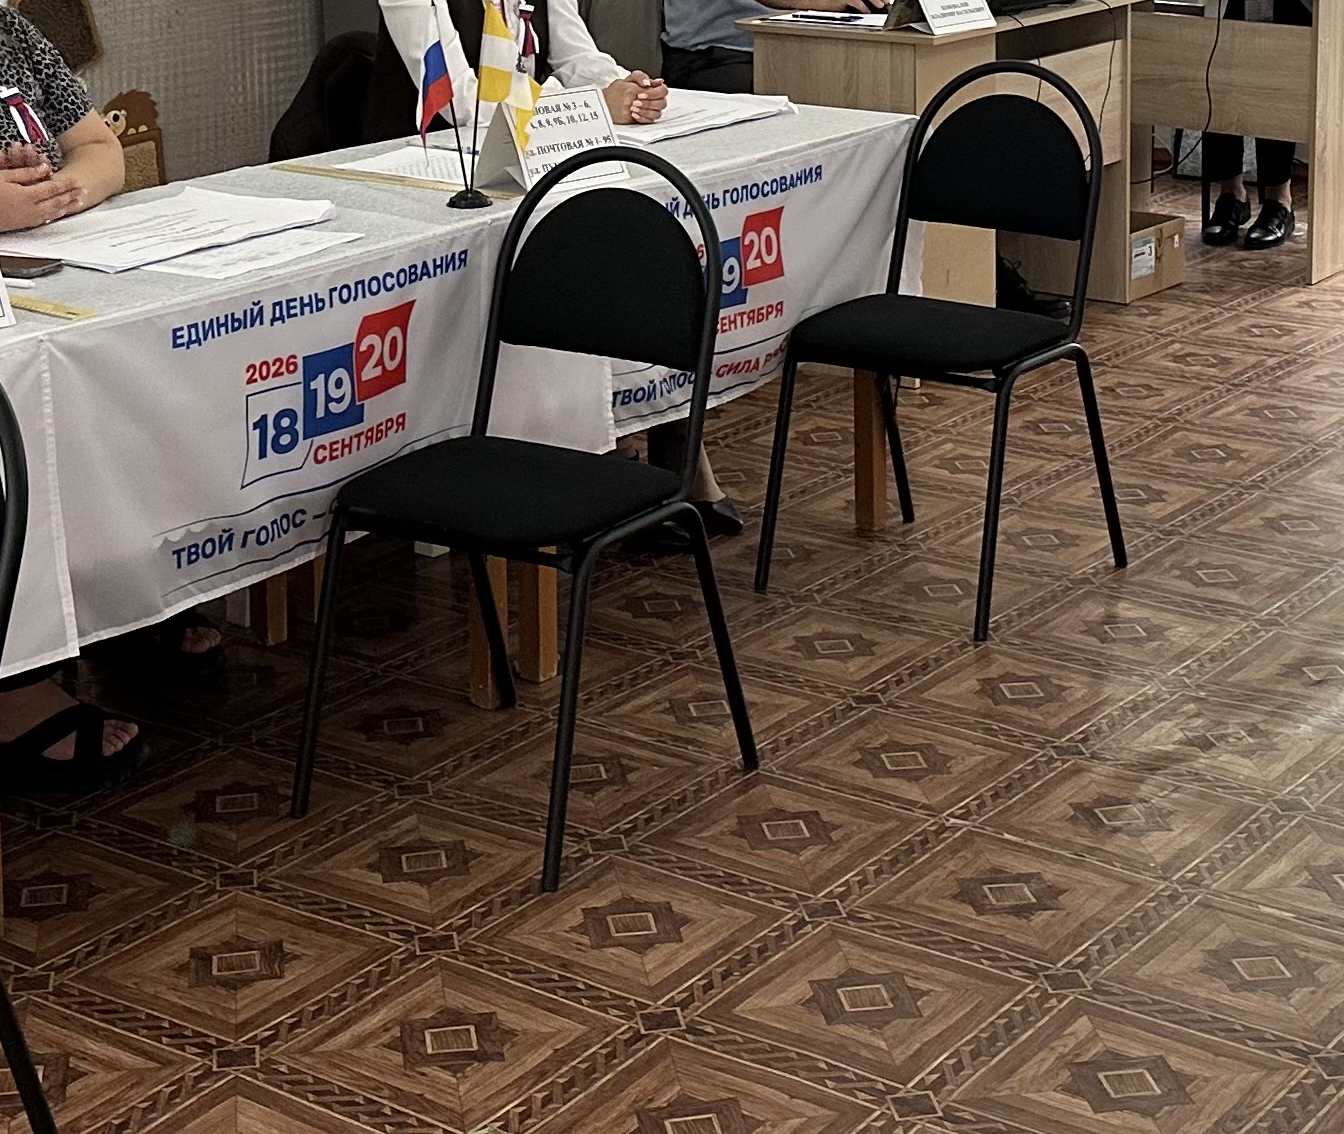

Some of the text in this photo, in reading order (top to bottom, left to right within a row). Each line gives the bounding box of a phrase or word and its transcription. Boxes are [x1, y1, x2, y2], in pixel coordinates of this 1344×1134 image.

[536, 139, 584, 156] ПОЧТОВАЯ
[683, 192, 720, 220] ДНЬ
[723, 164, 823, 207] ГОЛОСОВАНИЯ
[743, 226, 778, 270] 20
[171, 249, 469, 351] ЕДИНЫЙ ДЕНЬ ГОЛОСОВАНИЯ
[716, 300, 784, 336] ЕНТЯБРЯ
[245, 354, 299, 385] 2026
[251, 325, 404, 461] 18 19 20
[312, 412, 407, 465] СЕНТЯБРЯ
[171, 527, 235, 570] ТВОЙ
[240, 508, 308, 549] ГОЛОС
